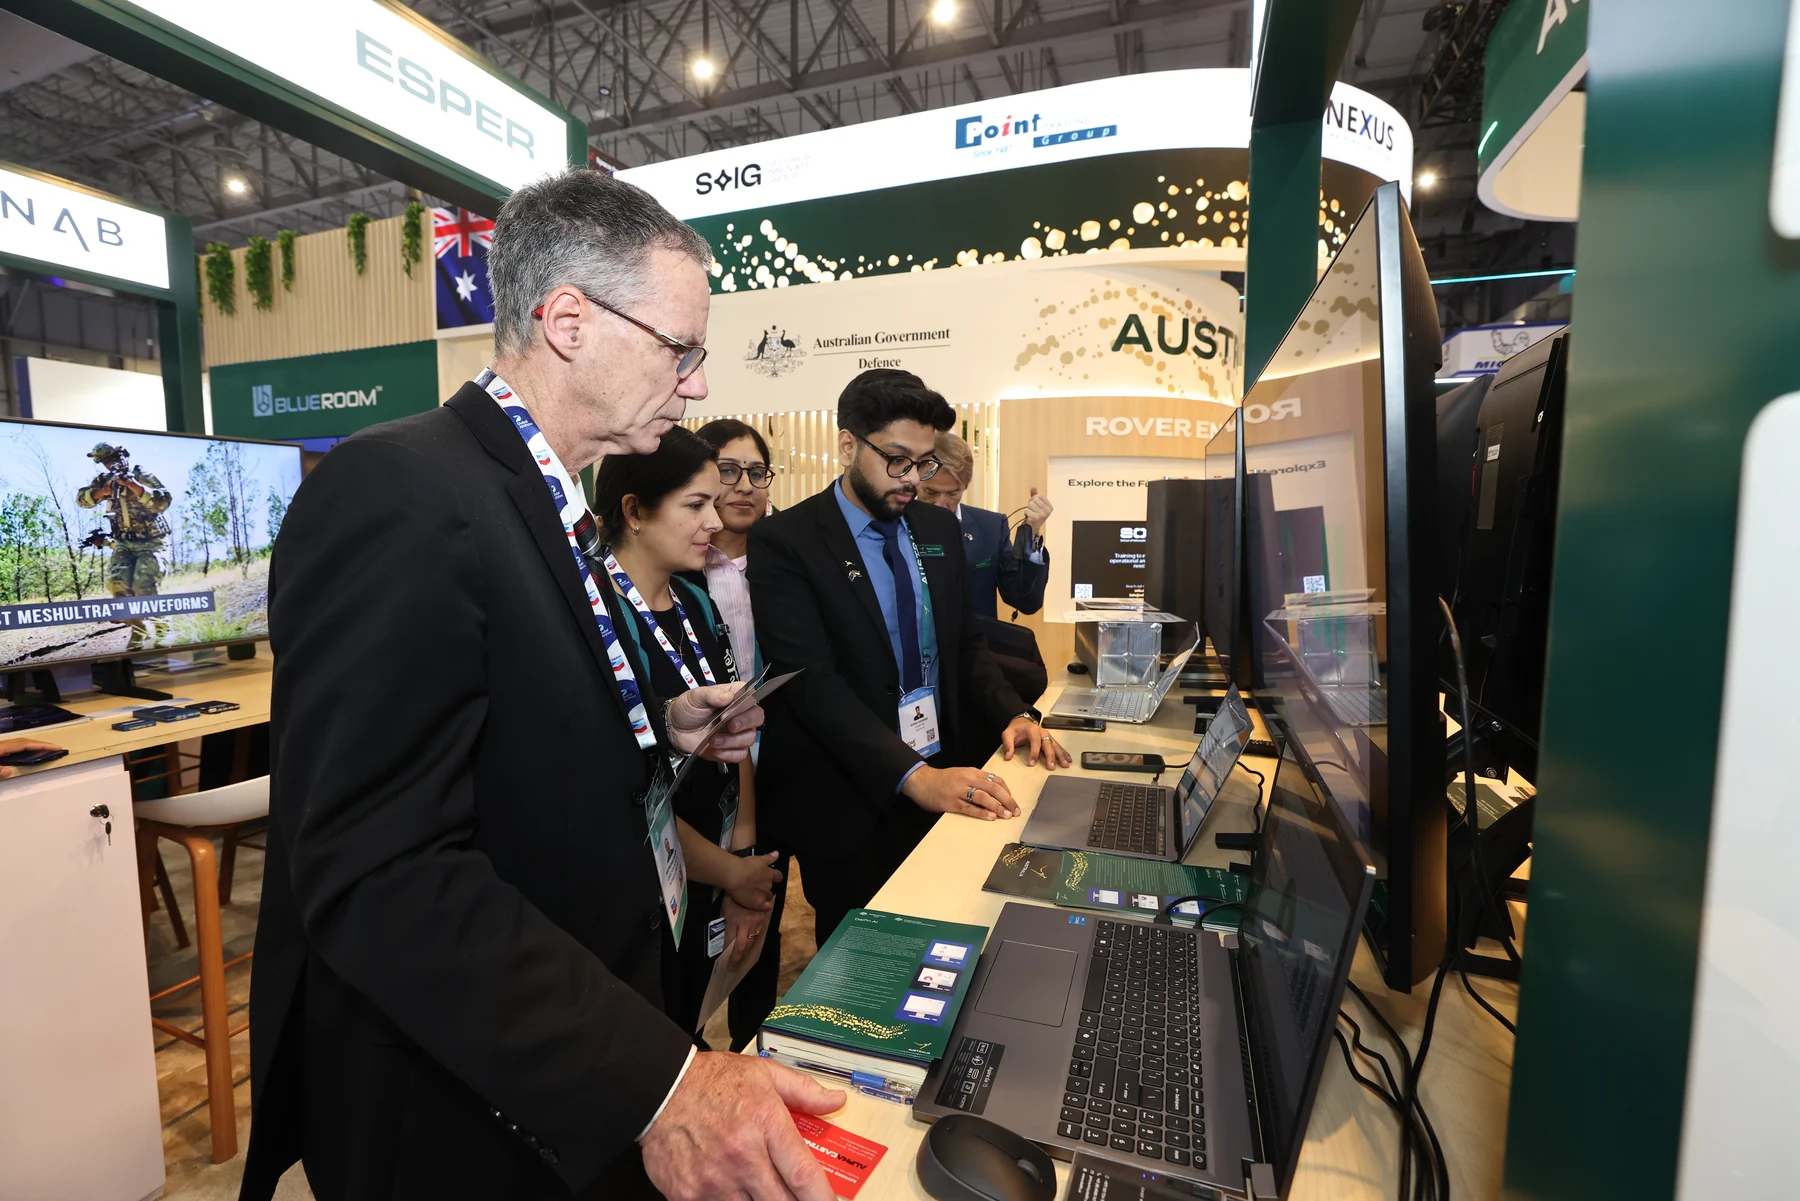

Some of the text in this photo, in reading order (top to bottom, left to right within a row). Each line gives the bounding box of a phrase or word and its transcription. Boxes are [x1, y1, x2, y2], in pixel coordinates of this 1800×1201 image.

[356, 29, 534, 160] ESPER
[1041, 127, 1110, 145] Group
[1326, 100, 1395, 152] NEXUS
[813, 328, 950, 349] Australian Government
[858, 357, 901, 369] Defence
[1086, 416, 1192, 438] ROVER
[1068, 478, 1113, 490] Explore
[1116, 478, 1136, 487] the
[128, 595, 209, 616] WAVEFORMS
